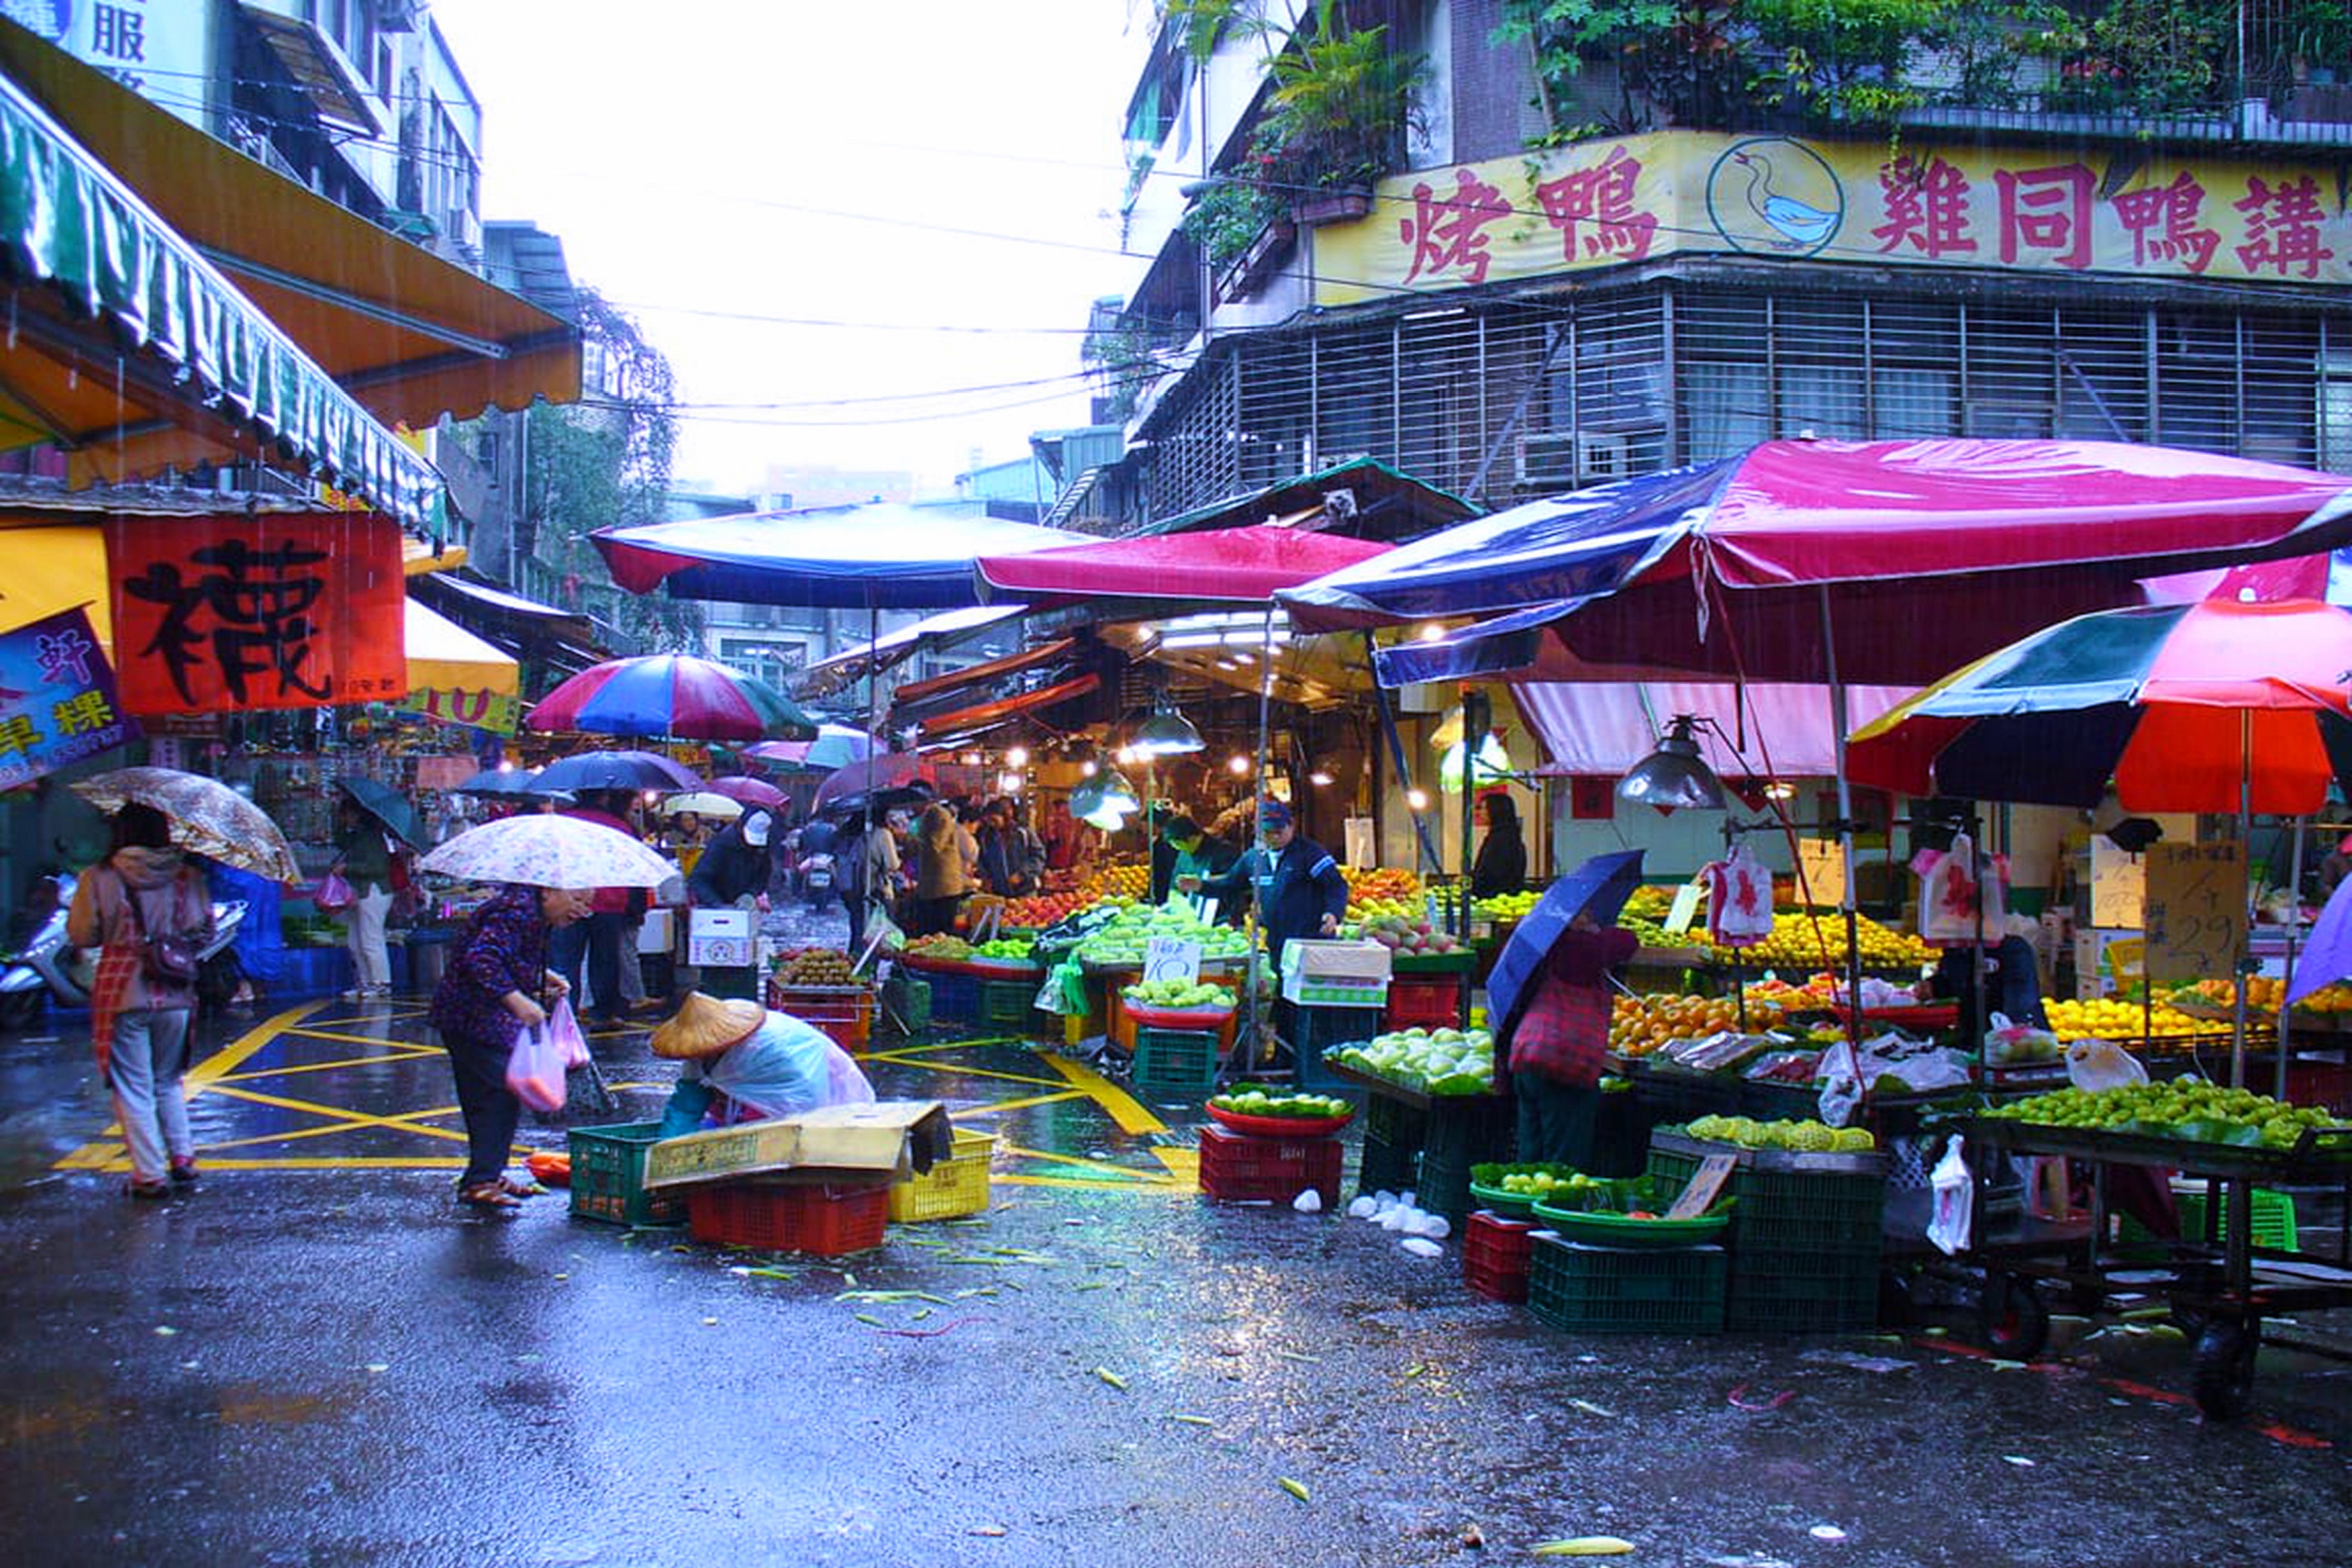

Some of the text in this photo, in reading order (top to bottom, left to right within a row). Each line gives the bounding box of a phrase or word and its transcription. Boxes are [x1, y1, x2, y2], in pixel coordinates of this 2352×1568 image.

[1399, 144, 1659, 285] 烤鴨
[1871, 154, 2335, 279] 雞同鴨講
